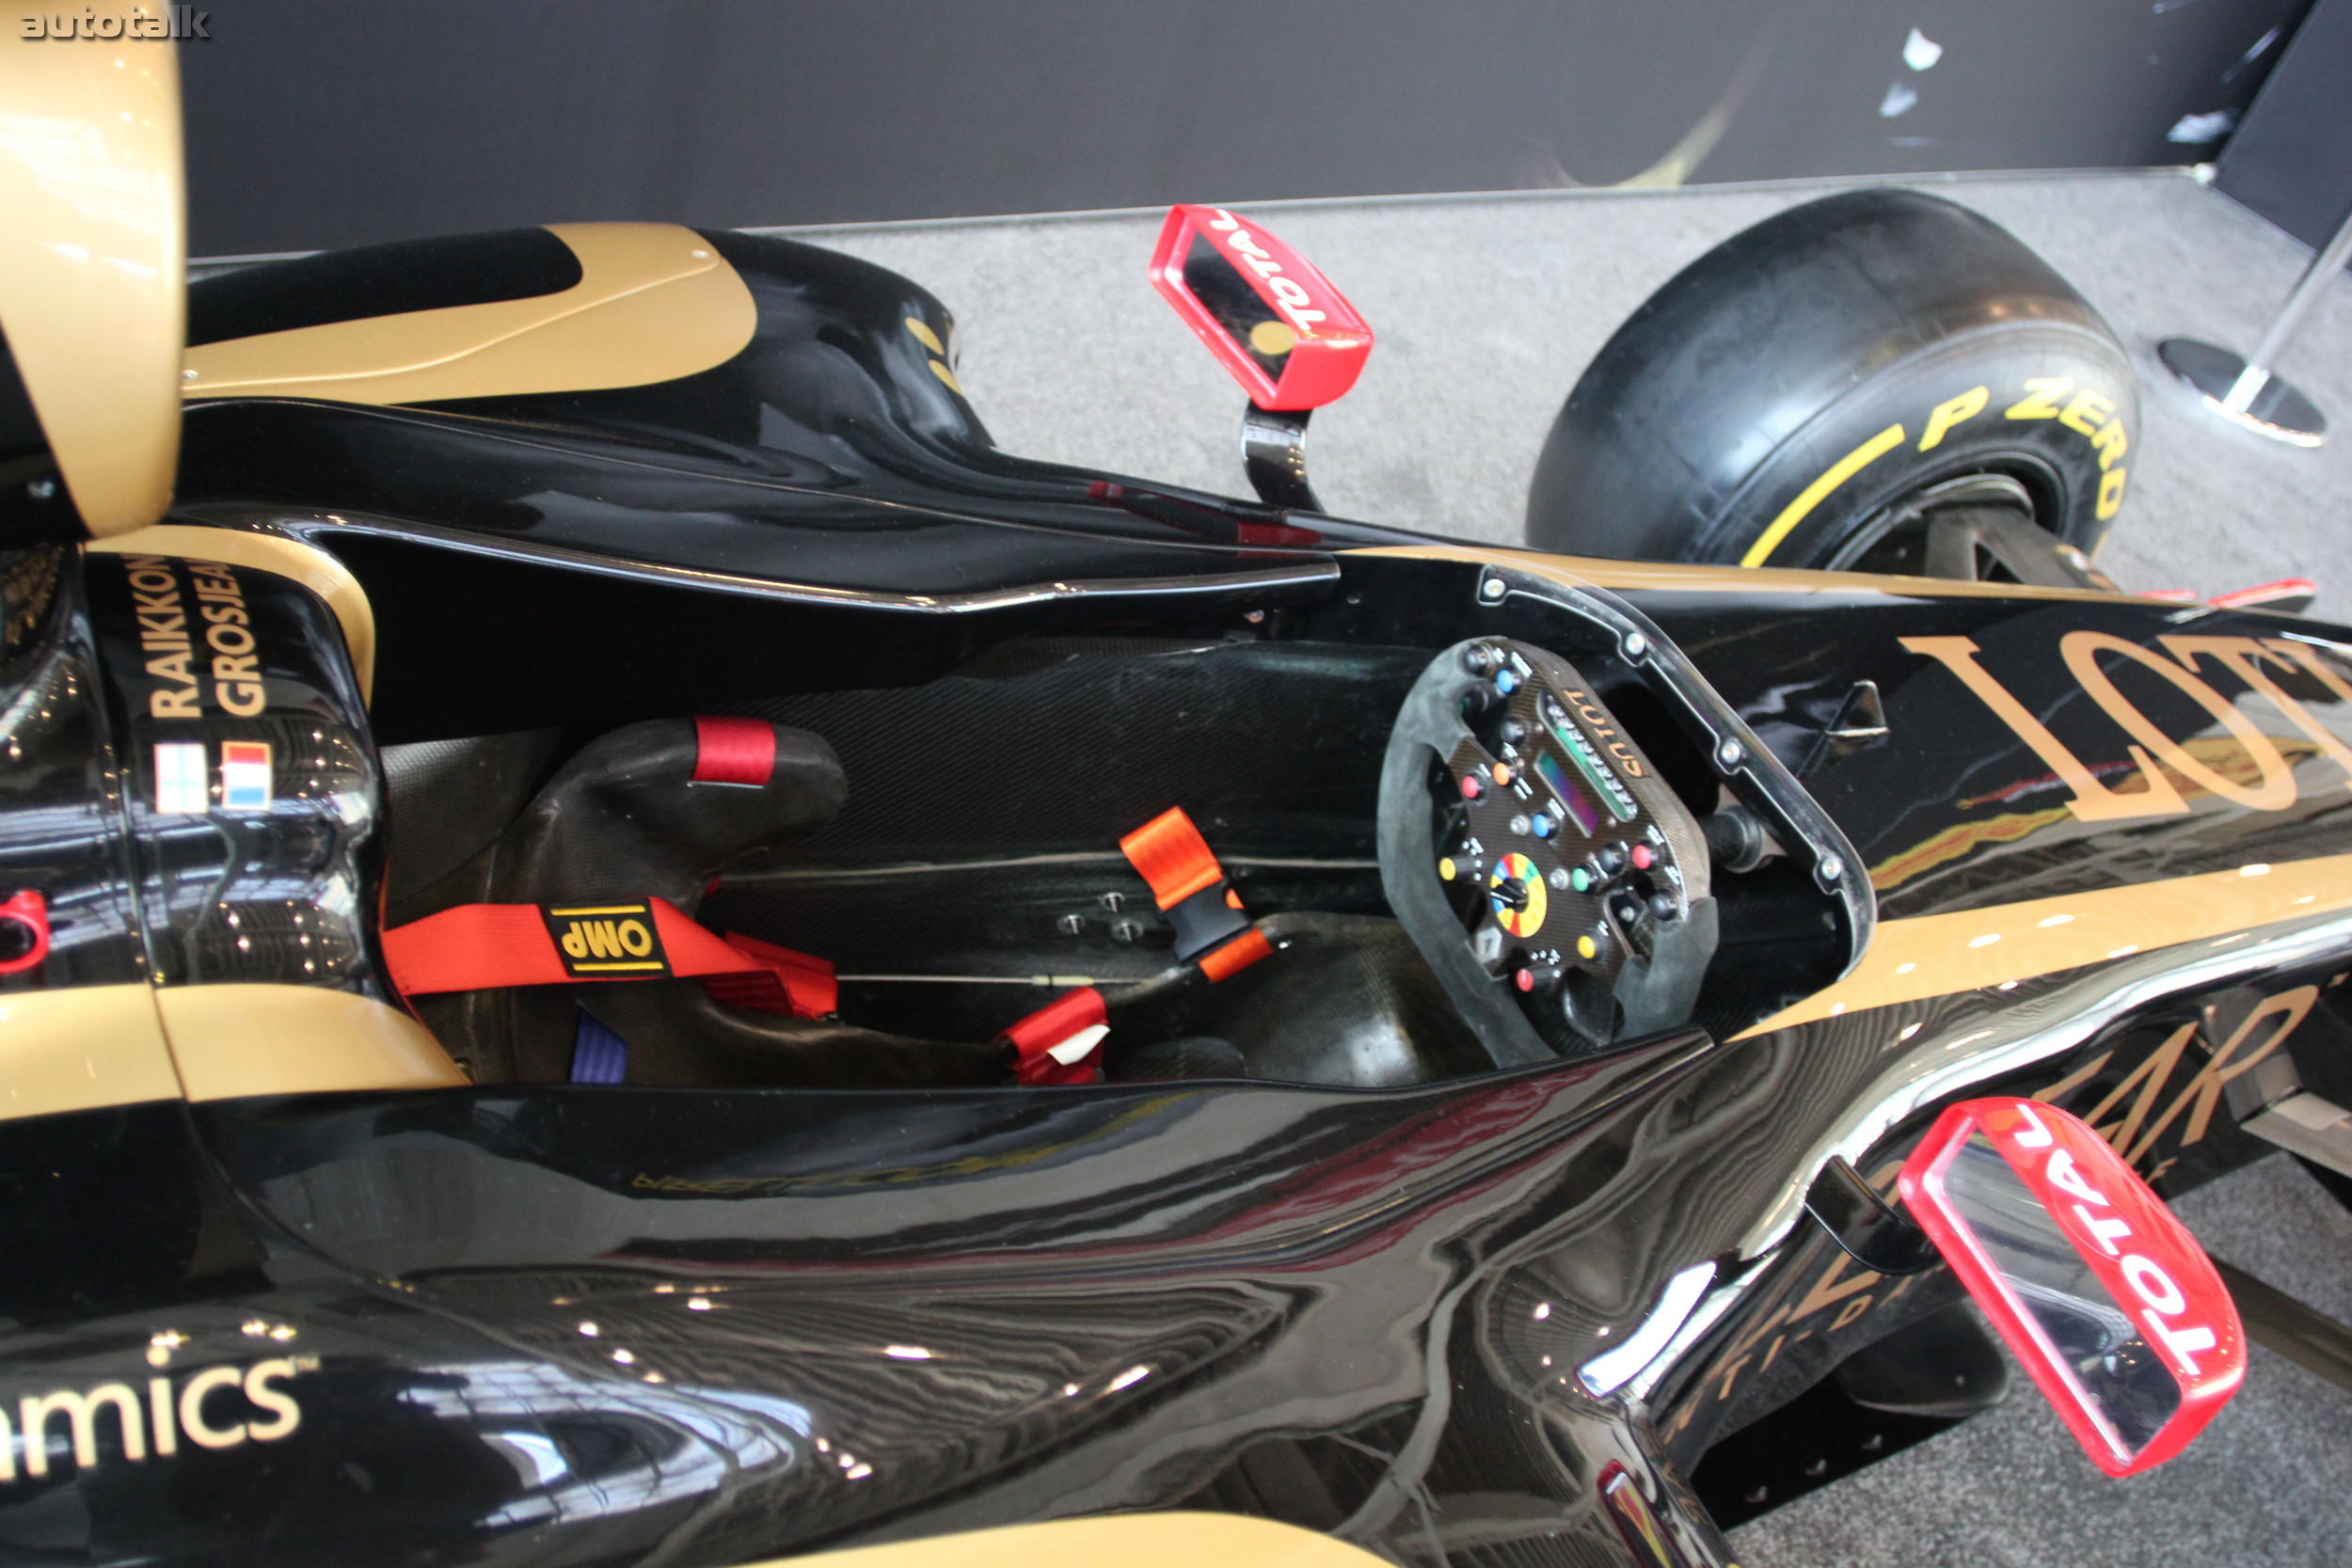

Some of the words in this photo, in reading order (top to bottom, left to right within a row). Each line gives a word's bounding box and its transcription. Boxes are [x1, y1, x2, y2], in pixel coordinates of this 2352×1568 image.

[1209, 208, 1327, 331] TOTAL
[1917, 385, 1990, 452] P
[2004, 376, 2128, 521] ZERO
[1563, 688, 1648, 777] LOTUS
[561, 919, 653, 958] OMP
[2013, 1103, 2217, 1376] TOTAL
